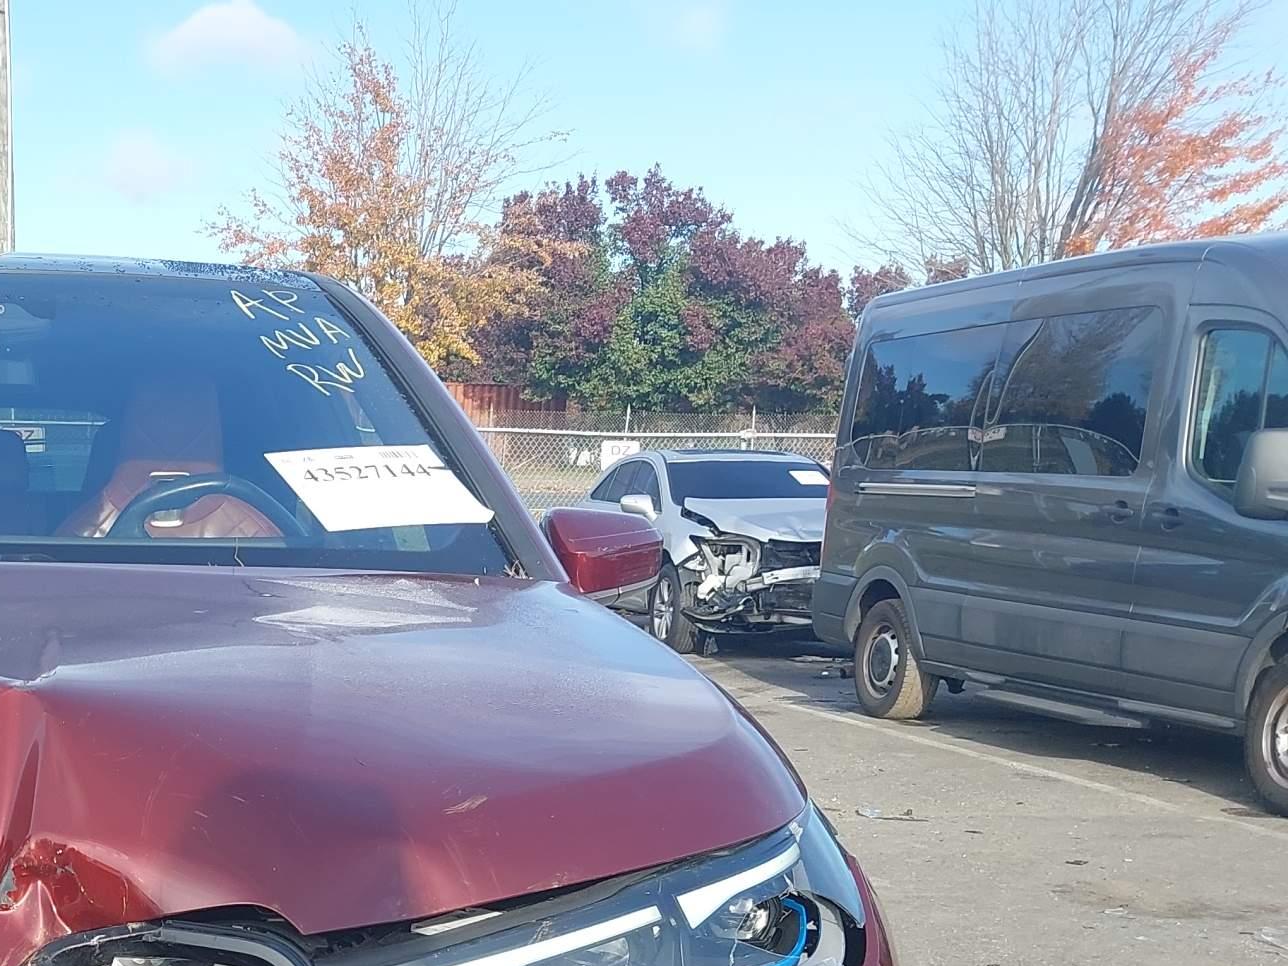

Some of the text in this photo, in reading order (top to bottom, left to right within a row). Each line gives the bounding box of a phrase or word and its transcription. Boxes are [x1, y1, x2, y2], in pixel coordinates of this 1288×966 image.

[230, 289, 305, 320] AP
[259, 316, 351, 359] MVA
[286, 347, 366, 396] RW
[610, 445, 632, 456] DZ
[303, 463, 432, 482] 43527144
